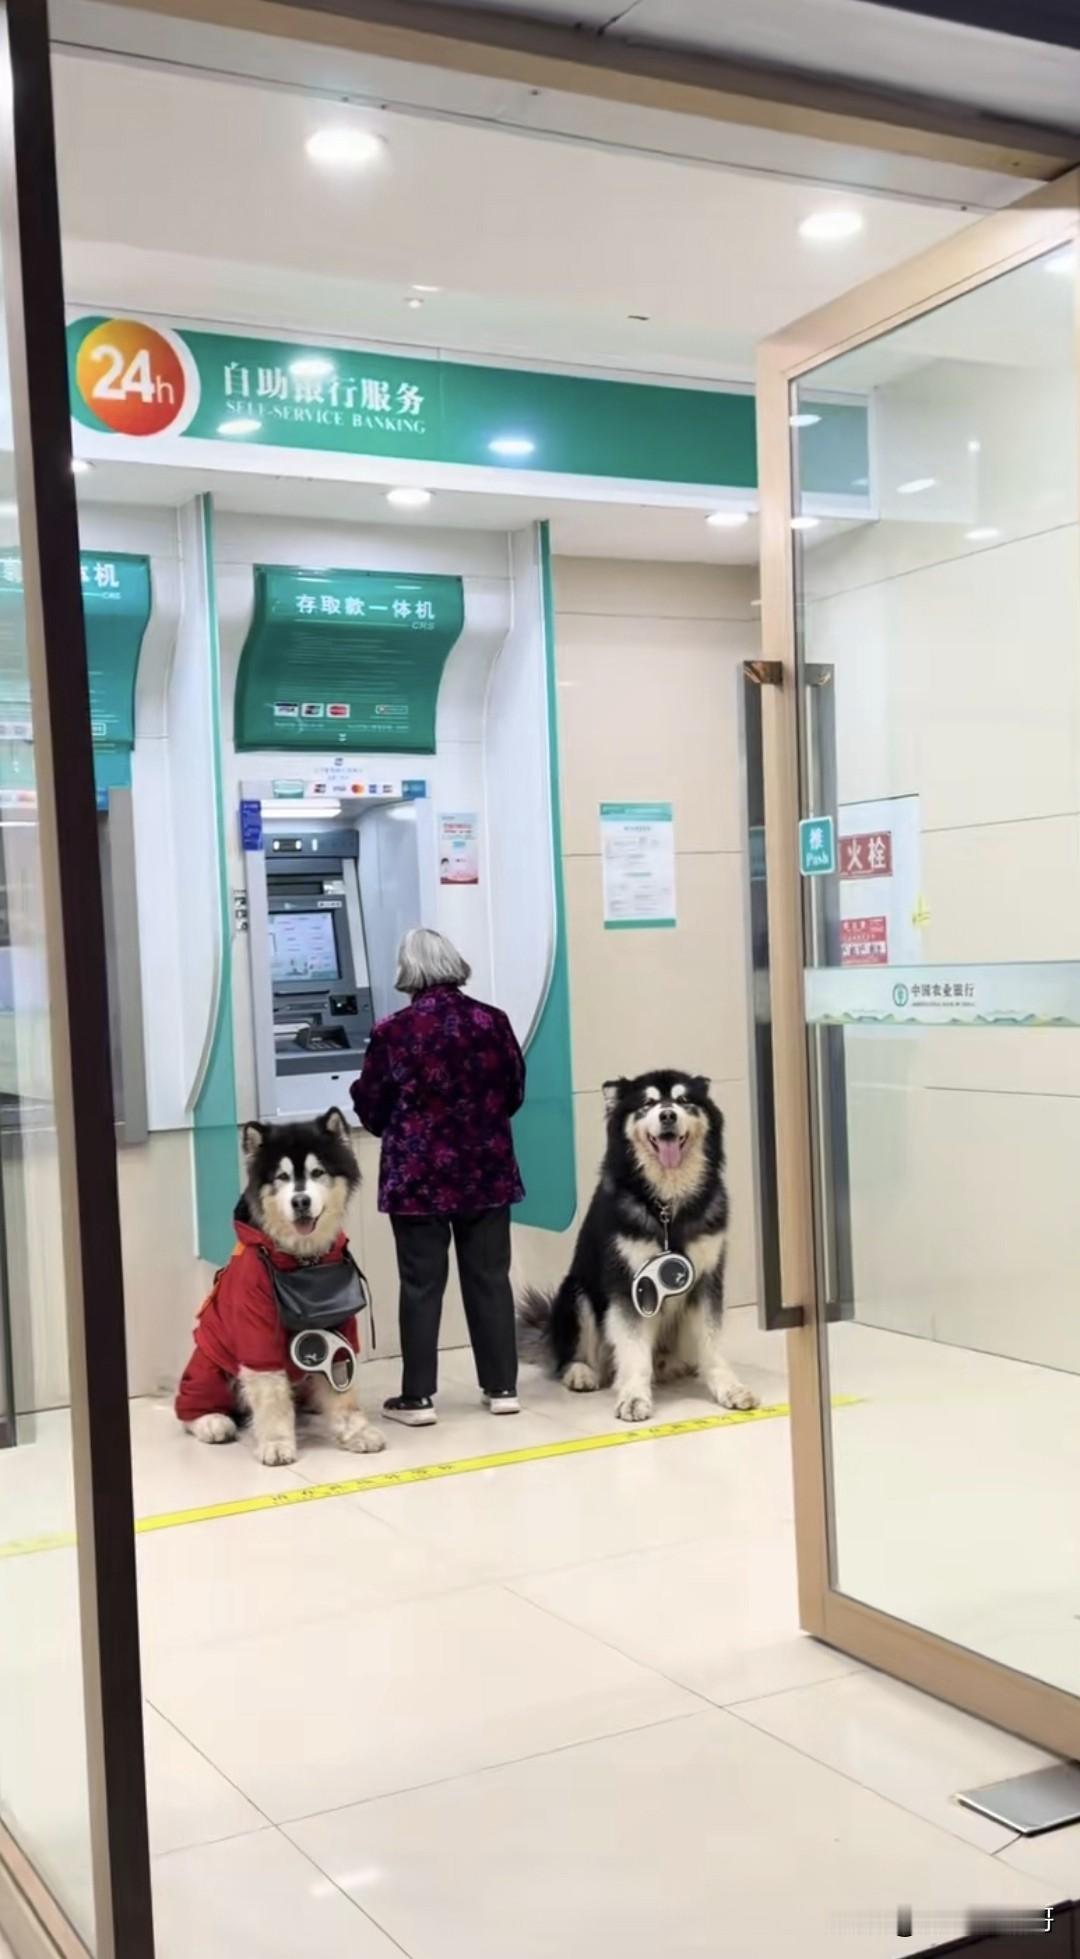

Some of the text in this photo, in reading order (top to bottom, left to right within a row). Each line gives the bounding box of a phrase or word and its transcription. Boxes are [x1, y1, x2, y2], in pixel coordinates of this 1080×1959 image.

[90, 344, 175, 405] 24h
[224, 361, 425, 416] 自助银行服务
[226, 400, 426, 435] SELF-SERVICE BANKING
[296, 593, 436, 620] 存取款一体机
[911, 983, 975, 998] 中国农业银行
